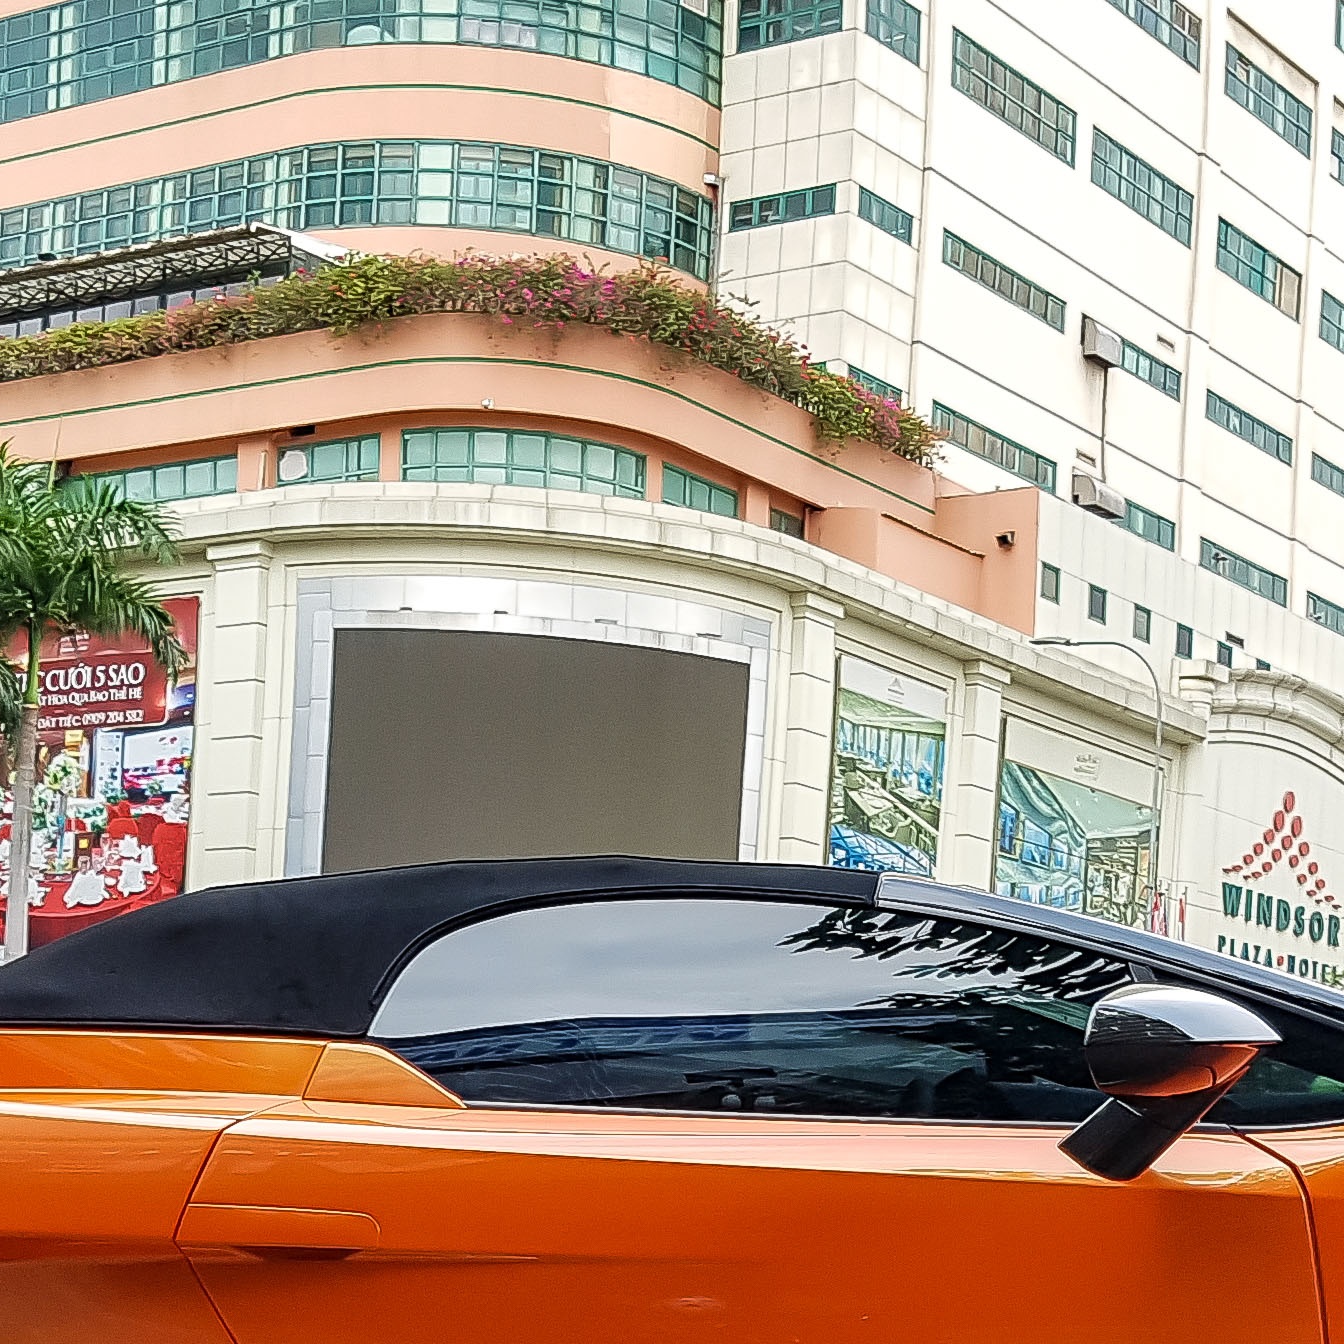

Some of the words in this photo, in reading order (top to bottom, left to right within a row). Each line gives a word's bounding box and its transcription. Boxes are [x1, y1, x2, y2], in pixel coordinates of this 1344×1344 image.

[95, 665, 106, 687] 5
[107, 662, 146, 686] SAO
[1221, 881, 1341, 948] WINDSOR
[1217, 934, 1273, 969] PLAZA
